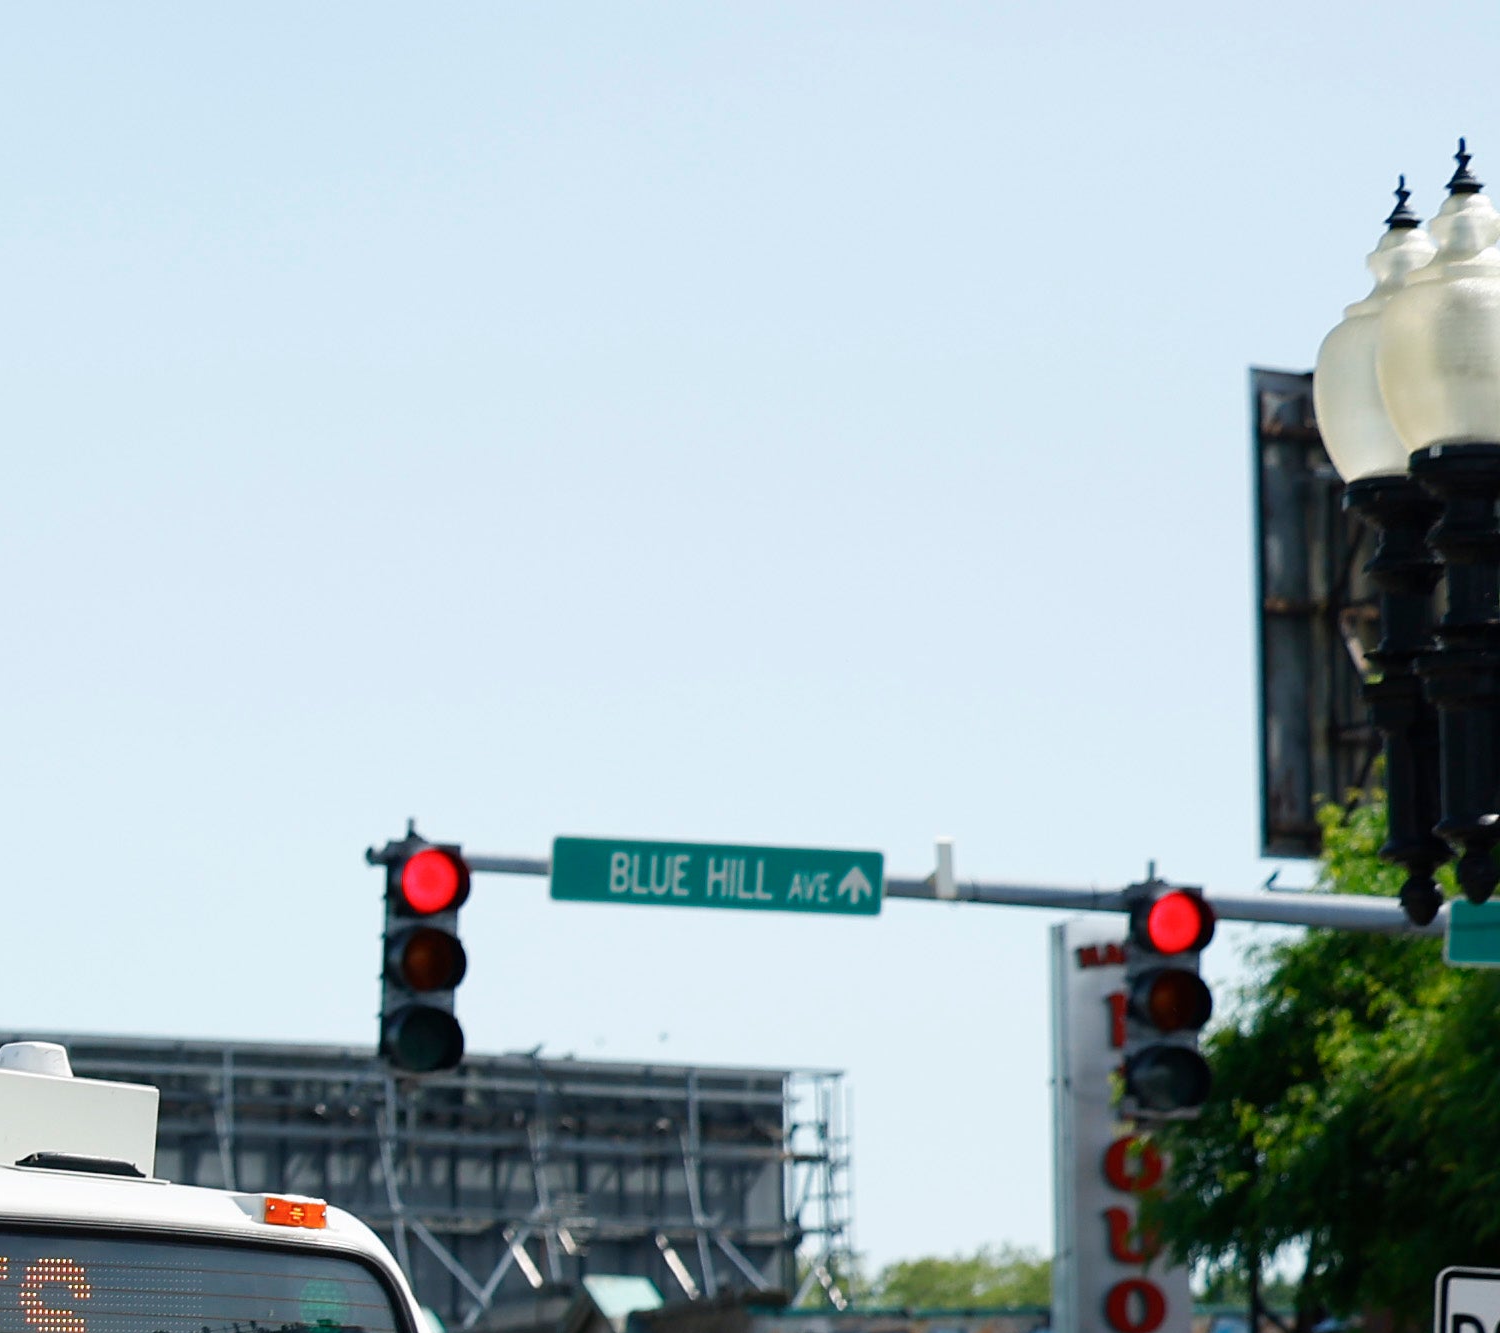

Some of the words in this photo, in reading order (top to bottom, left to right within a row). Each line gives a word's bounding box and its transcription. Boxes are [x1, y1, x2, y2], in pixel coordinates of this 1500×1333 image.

[609, 851, 690, 897] BLUE
[706, 856, 773, 901] HILL
[787, 871, 830, 903] AVE
